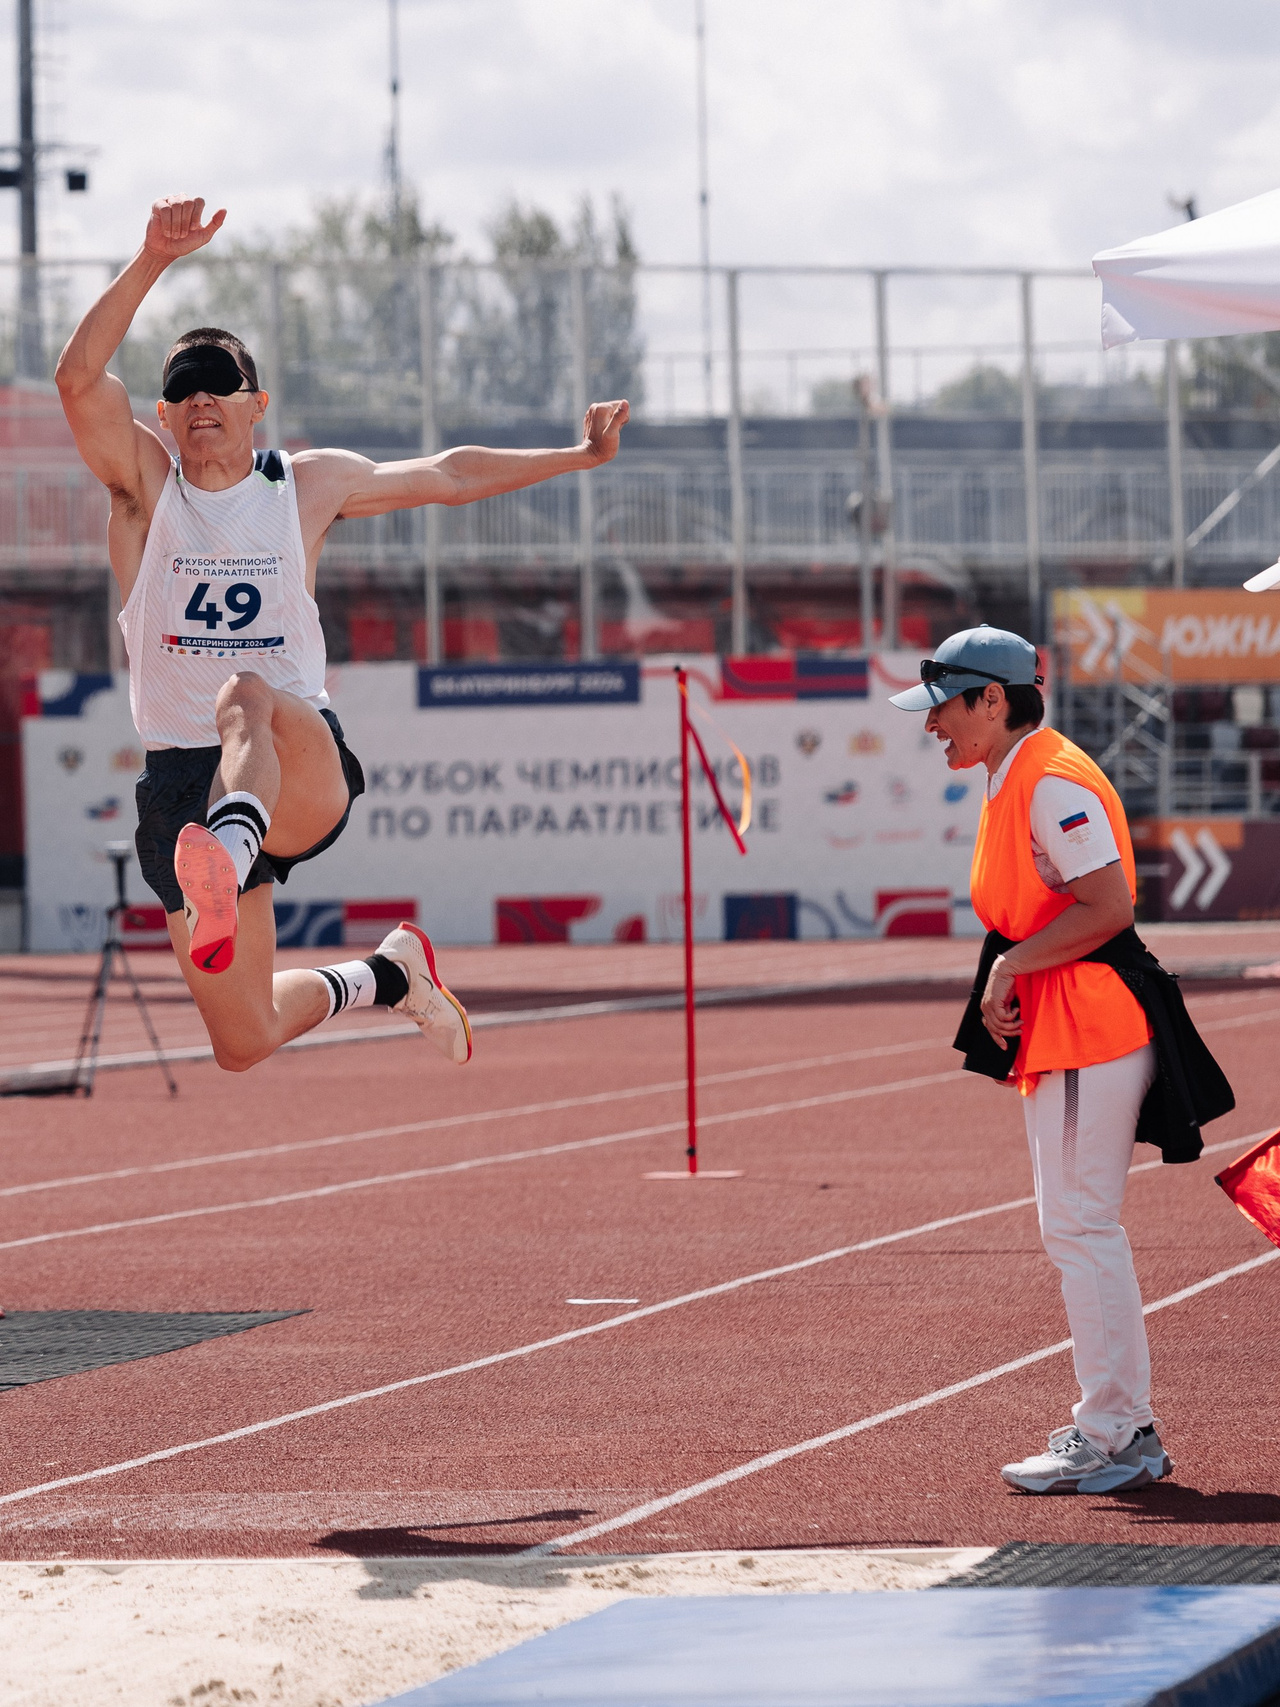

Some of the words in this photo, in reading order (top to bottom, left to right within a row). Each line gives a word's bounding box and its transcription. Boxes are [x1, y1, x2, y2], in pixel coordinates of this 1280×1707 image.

[185, 557, 217, 567] КУБОК
[220, 556, 277, 567] ЧЕМПИОНОВ
[185, 568, 200, 576] ПО
[203, 567, 278, 577] ПАРААТЛЕТИКЕ
[185, 582, 262, 631] 49
[181, 638, 243, 648] ЕКАТЕРИНБУРГ
[244, 640, 265, 648] 2024
[370, 759, 502, 796] КУБОК
[516, 754, 781, 794] ЧЕМПИОНОВ
[369, 805, 433, 840] ПО
[447, 799, 782, 839] ПАРААТЛЕИЕ
